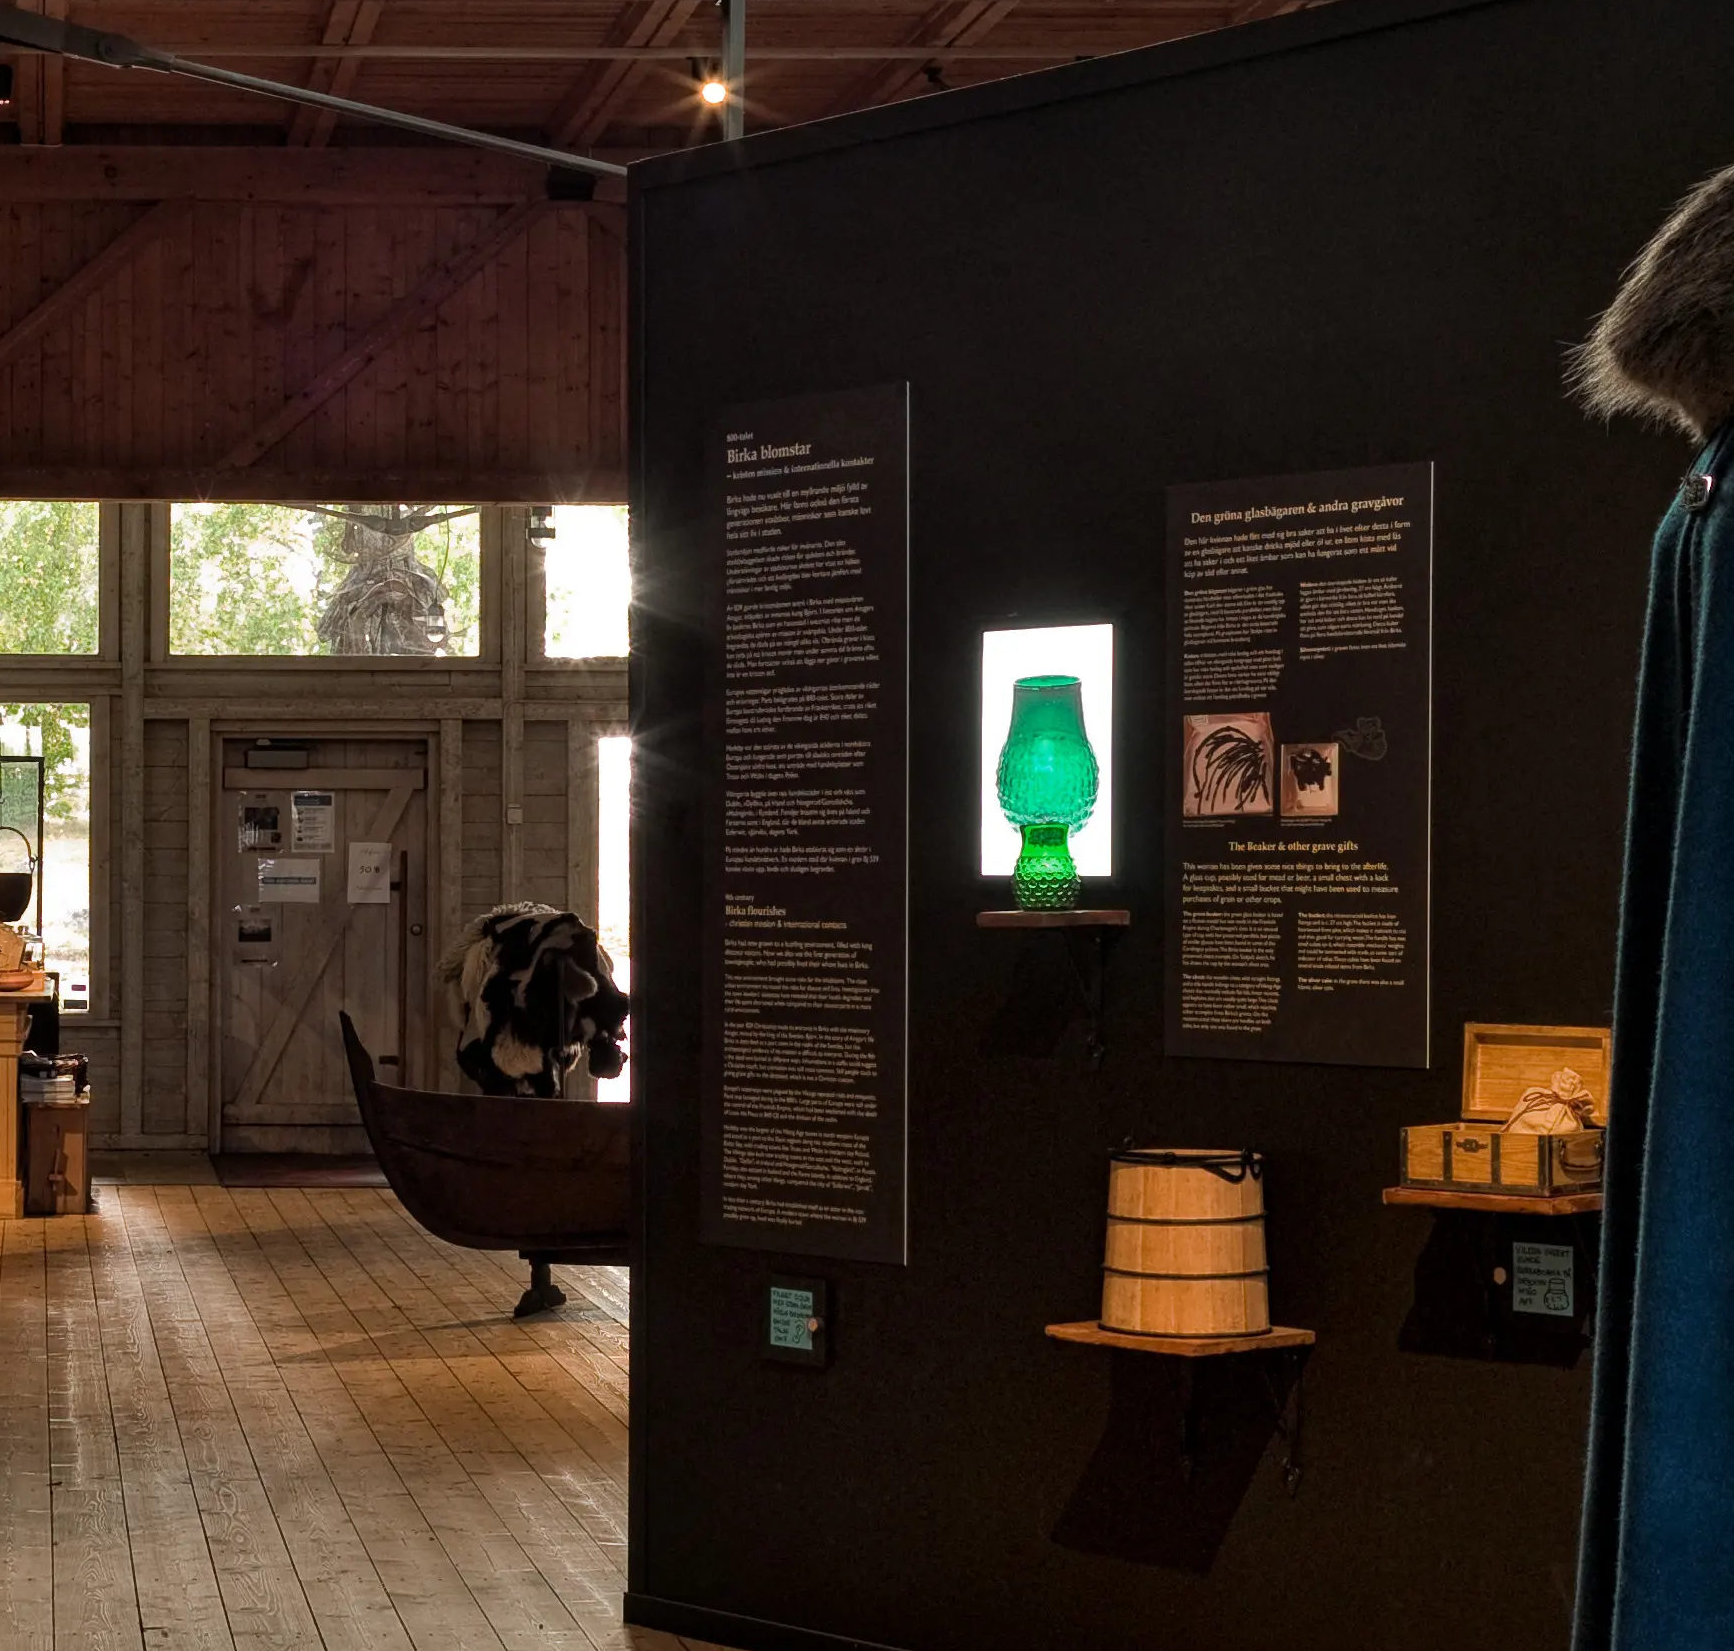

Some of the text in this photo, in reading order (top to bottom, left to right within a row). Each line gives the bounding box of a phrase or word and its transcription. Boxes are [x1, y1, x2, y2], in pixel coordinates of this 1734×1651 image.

[727, 443, 811, 463] Birka blomstar
[732, 470, 755, 479] kristen
[840, 456, 874, 467] kontakter
[1191, 496, 1404, 525] Den gröna glasbägaren & andra gravgåvor
[1228, 840, 1358, 853] The Beaker & other grave gifts
[360, 865, 372, 875] 50
[1350, 862, 1361, 870] the
[725, 905, 786, 915] Birka flourishes
[783, 920, 820, 928] international
